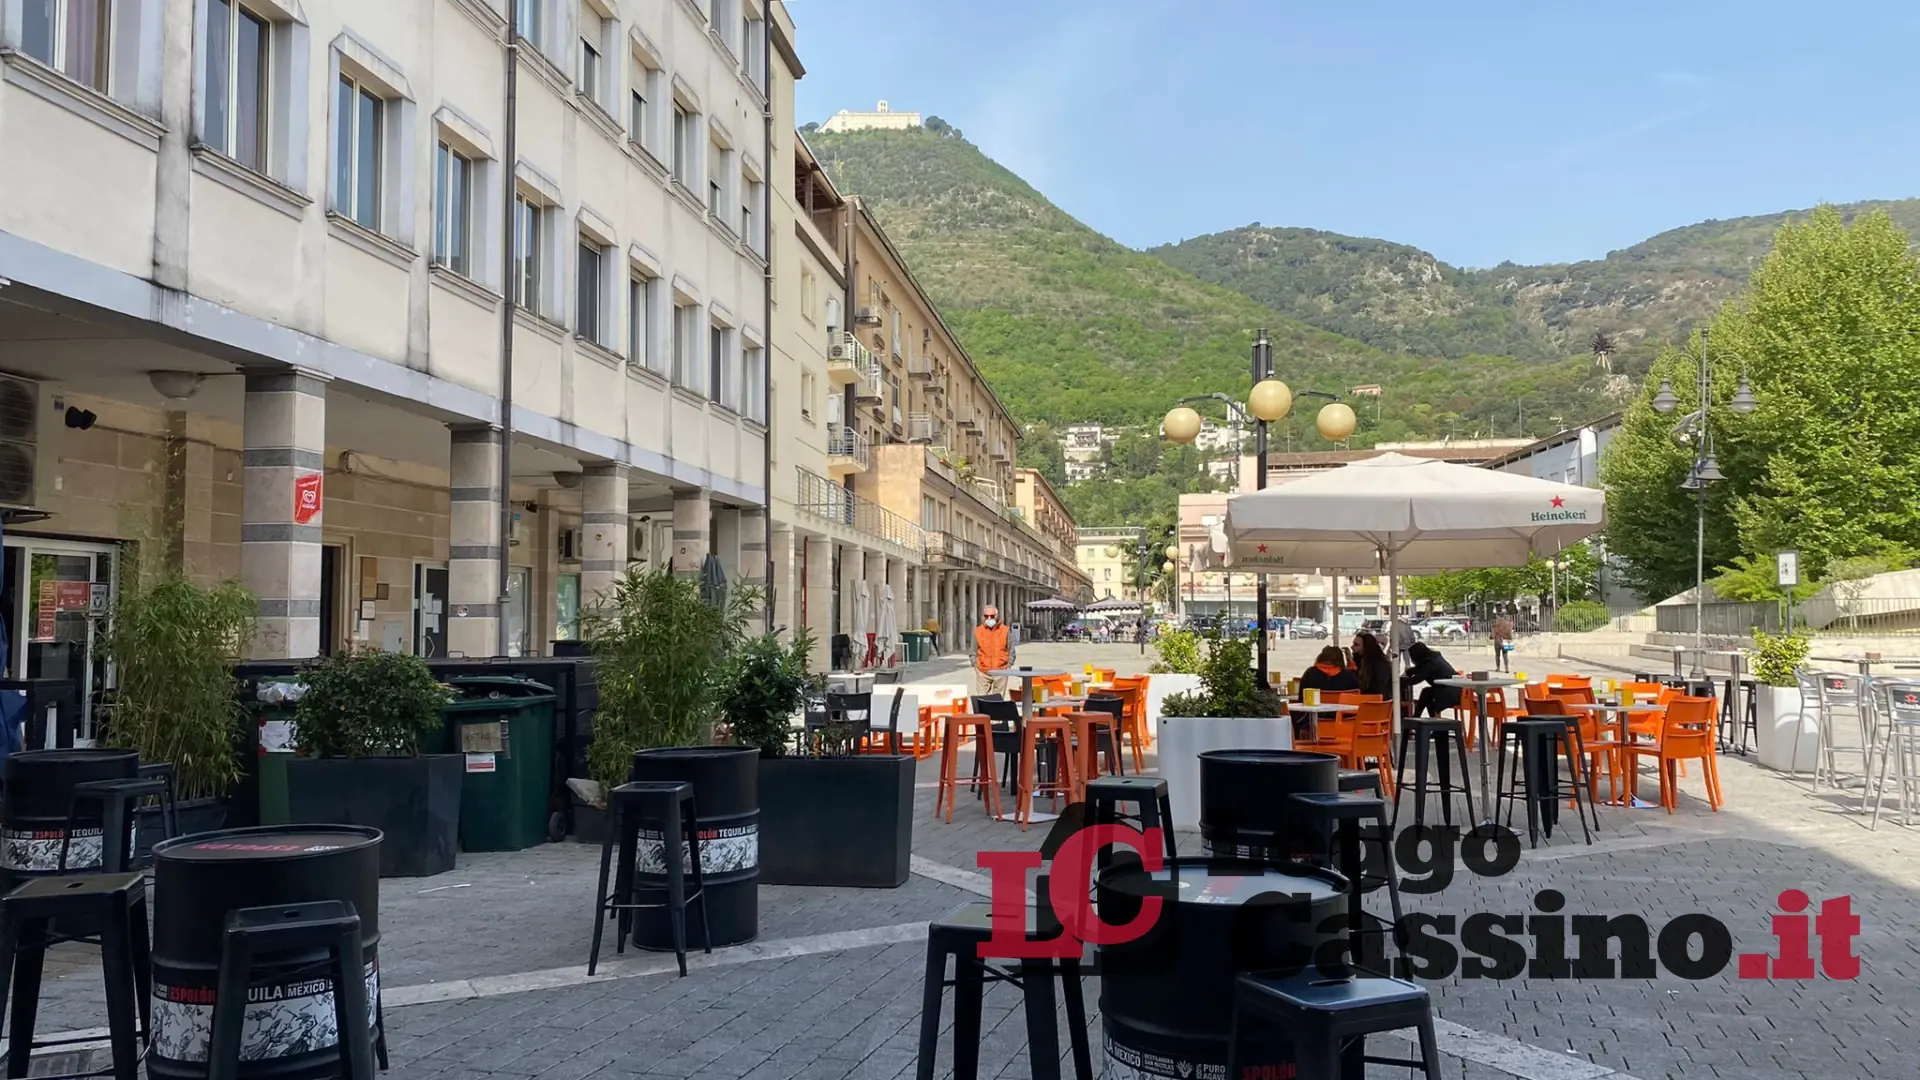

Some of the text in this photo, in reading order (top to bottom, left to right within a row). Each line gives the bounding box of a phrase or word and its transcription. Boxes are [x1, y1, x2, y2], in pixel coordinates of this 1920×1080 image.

[1531, 510, 1586, 521] Heineken
[71, 828, 103, 837] TEQUIL
[718, 827, 746, 838] TEQUILA
[247, 985, 284, 1002] UILA
[1203, 1064, 1226, 1074] PURO
